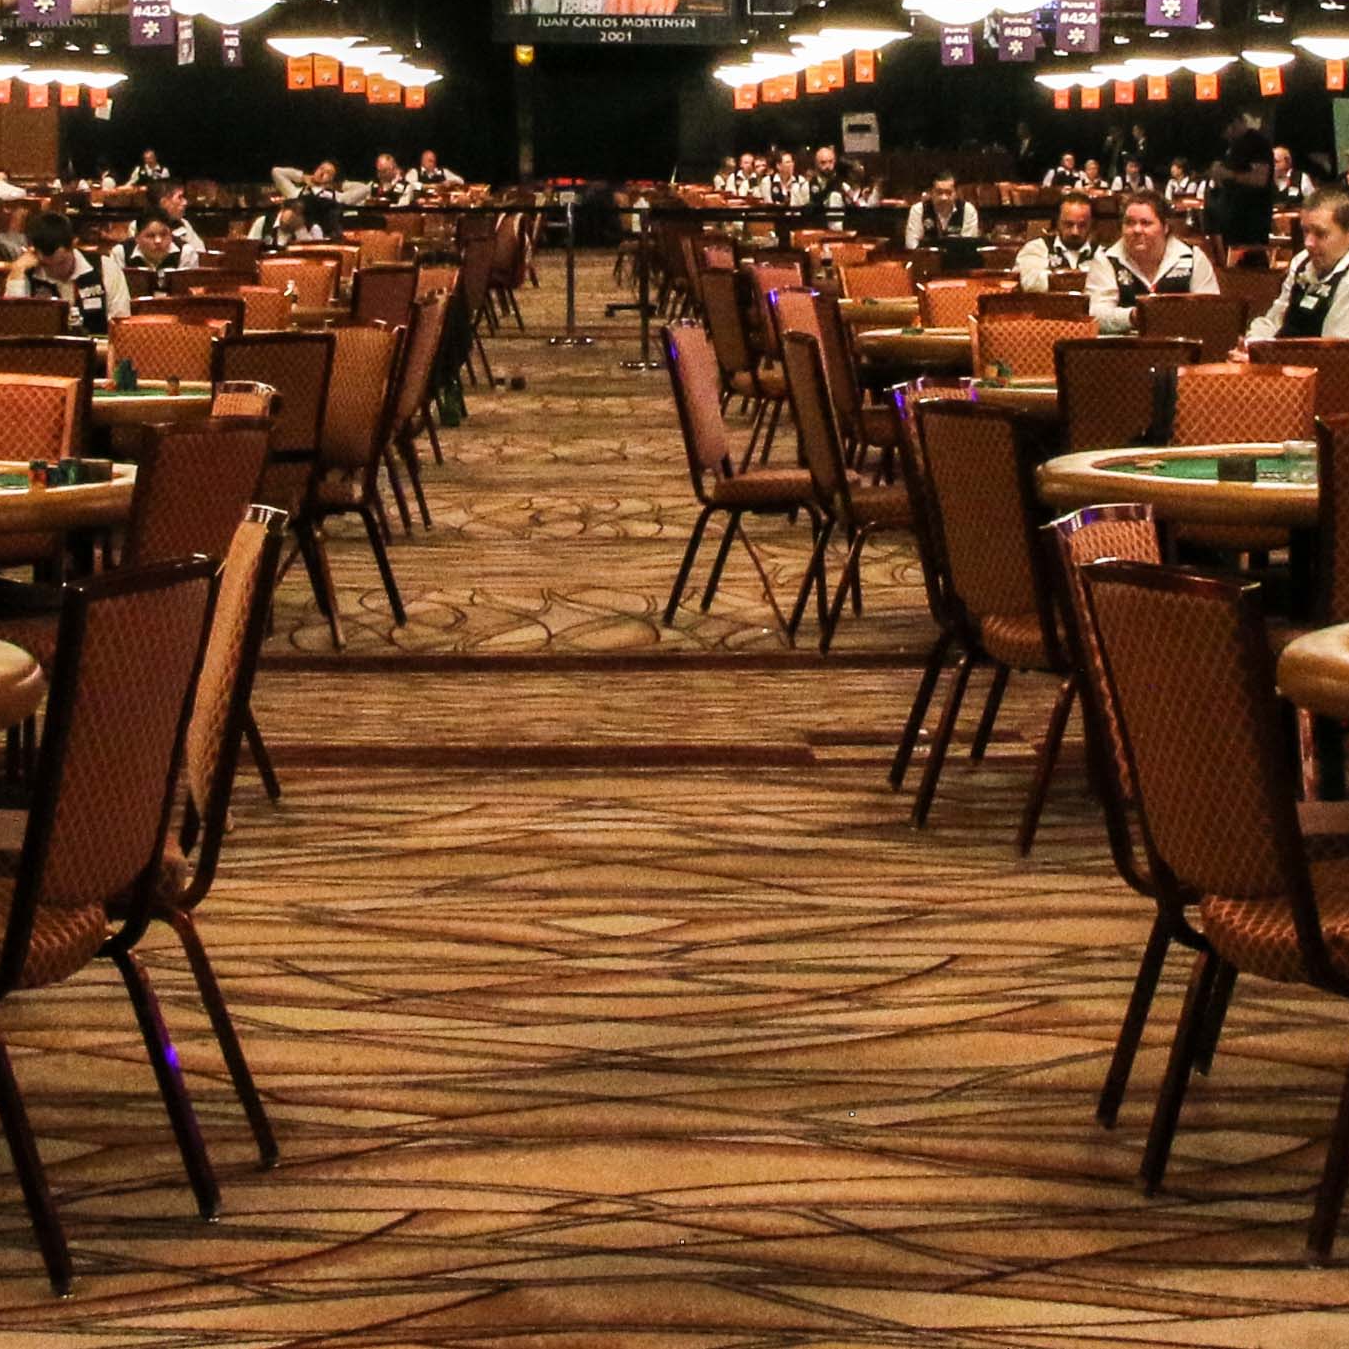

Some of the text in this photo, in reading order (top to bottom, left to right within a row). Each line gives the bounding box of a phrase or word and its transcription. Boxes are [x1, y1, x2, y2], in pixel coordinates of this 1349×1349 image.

[132, 5, 171, 18] #423
[537, 16, 696, 28] JUAN CARLOS MORTENSEN
[1059, 12, 1098, 25] #424
[599, 31, 633, 42] 2001
